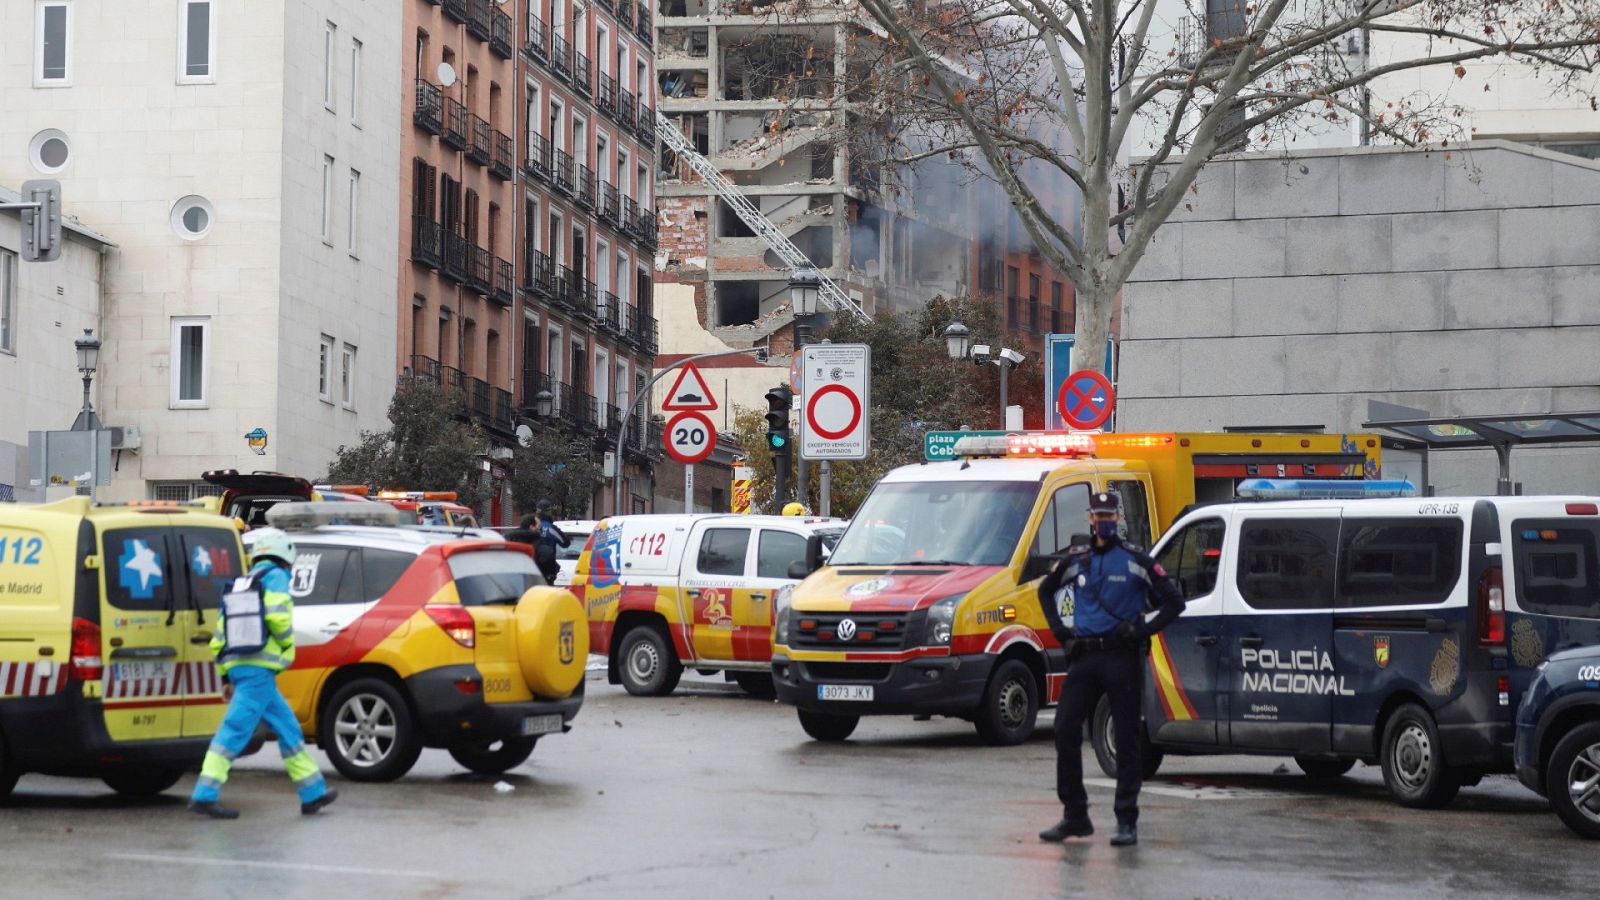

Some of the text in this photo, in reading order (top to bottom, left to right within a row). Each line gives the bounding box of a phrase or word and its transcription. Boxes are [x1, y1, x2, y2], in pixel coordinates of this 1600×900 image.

[675, 428, 705, 446] 20
[929, 435, 954, 444] plaza
[8, 582, 43, 594] Madrid
[702, 588, 727, 625] 25
[1241, 645, 1335, 672] POLICÍA
[824, 686, 870, 698] 3073 JKY
[1242, 671, 1356, 697] NACIONAL
